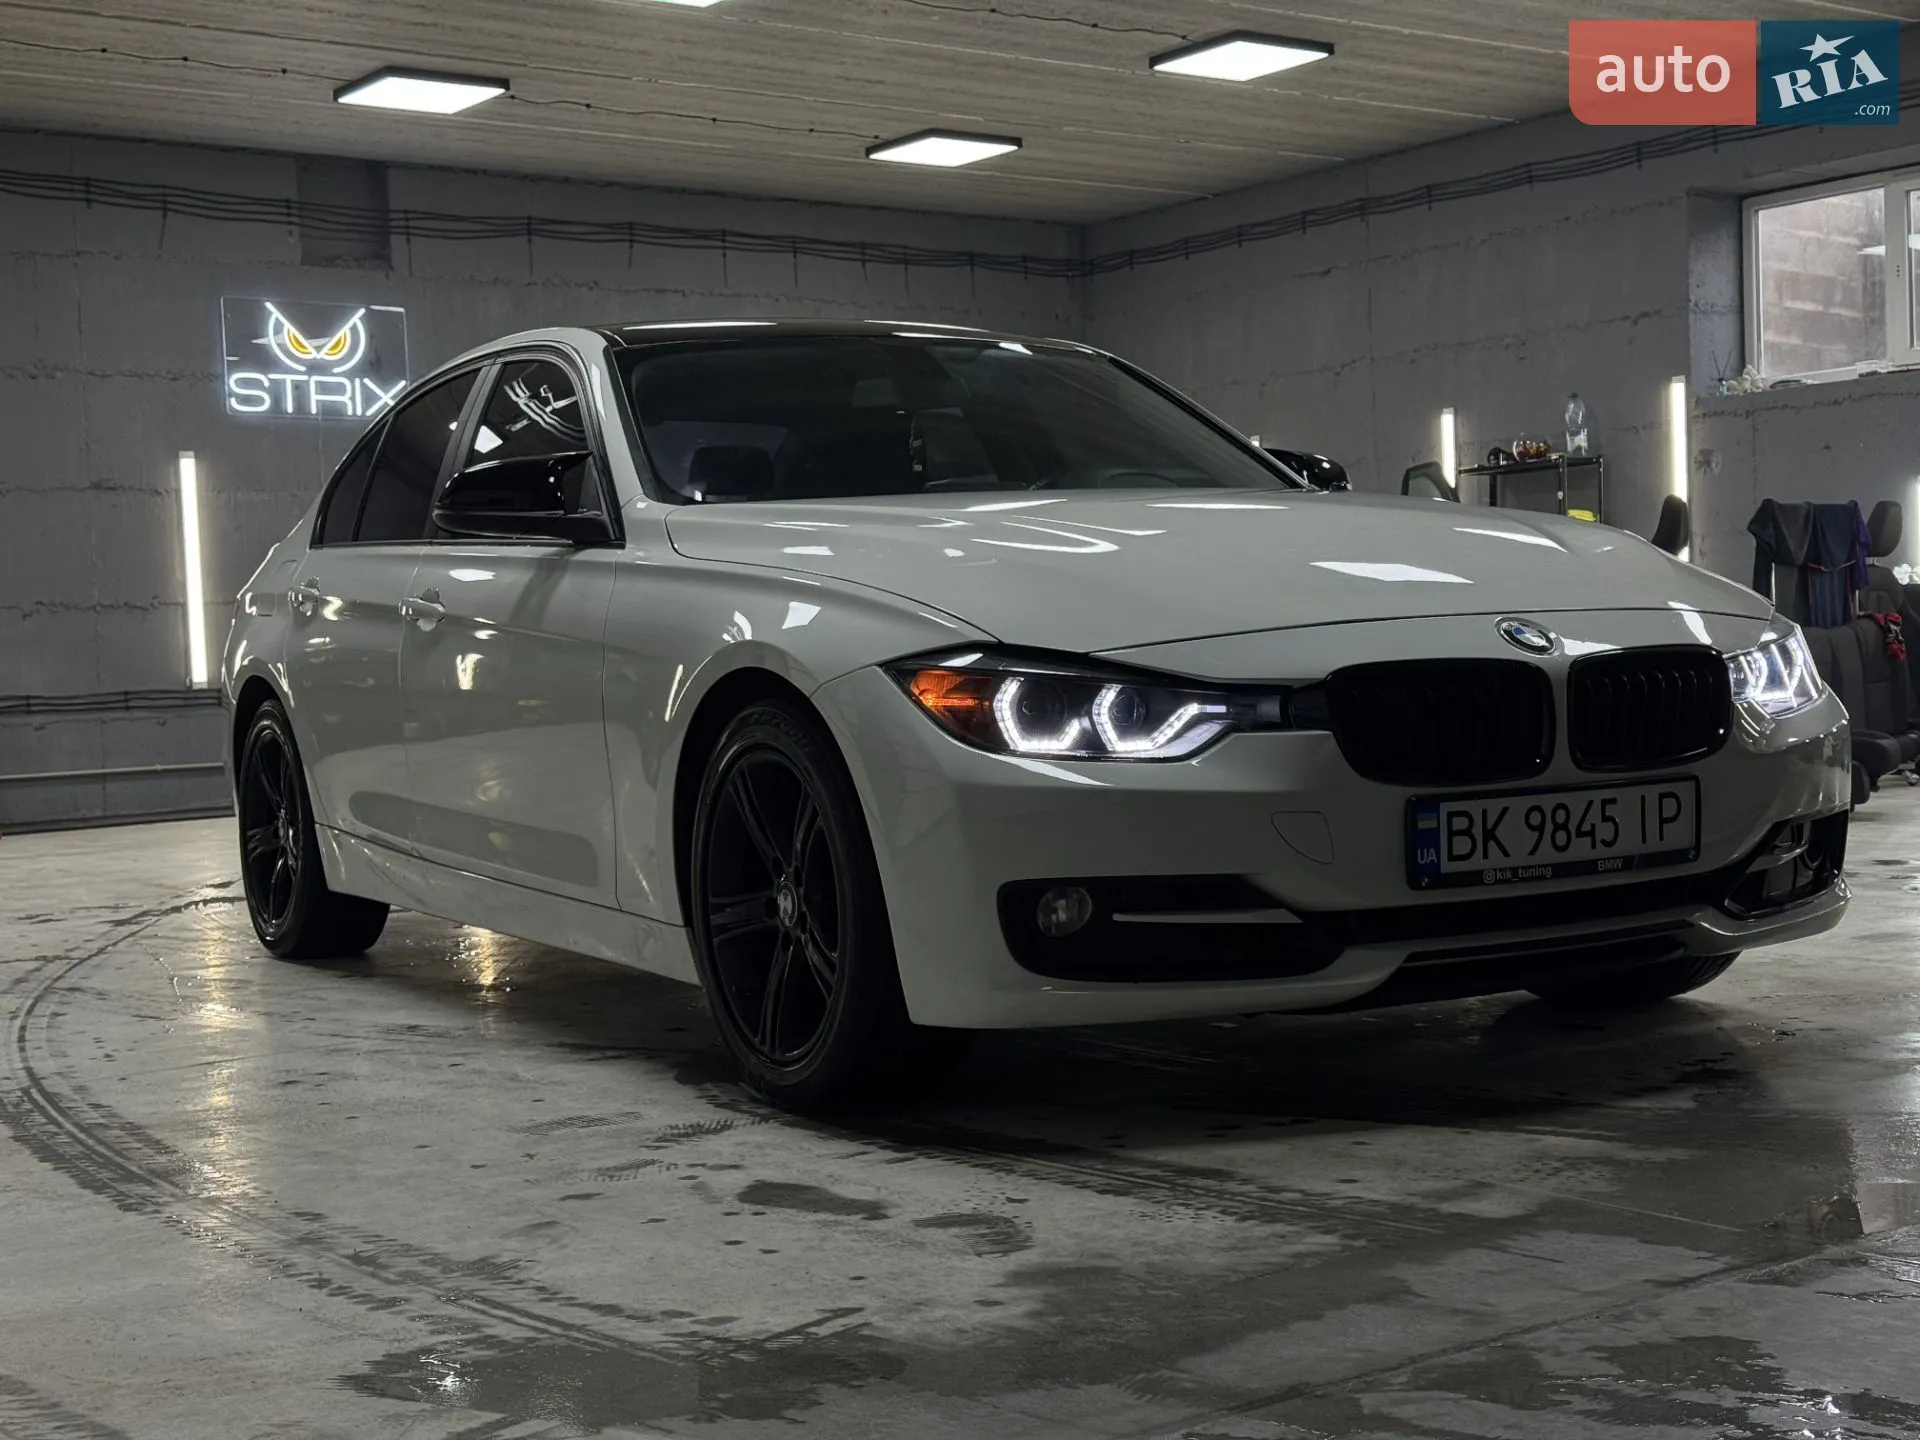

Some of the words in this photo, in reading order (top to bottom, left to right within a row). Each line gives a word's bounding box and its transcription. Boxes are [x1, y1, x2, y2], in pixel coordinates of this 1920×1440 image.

[228, 371, 407, 417] STRIX
[1446, 806, 1511, 862] BK
[1524, 797, 1620, 856] 9845
[1640, 791, 1682, 844] IP
[1417, 848, 1438, 864] UA
[1597, 858, 1623, 871] BMW
[1482, 865, 1552, 884] @kik_tuning
